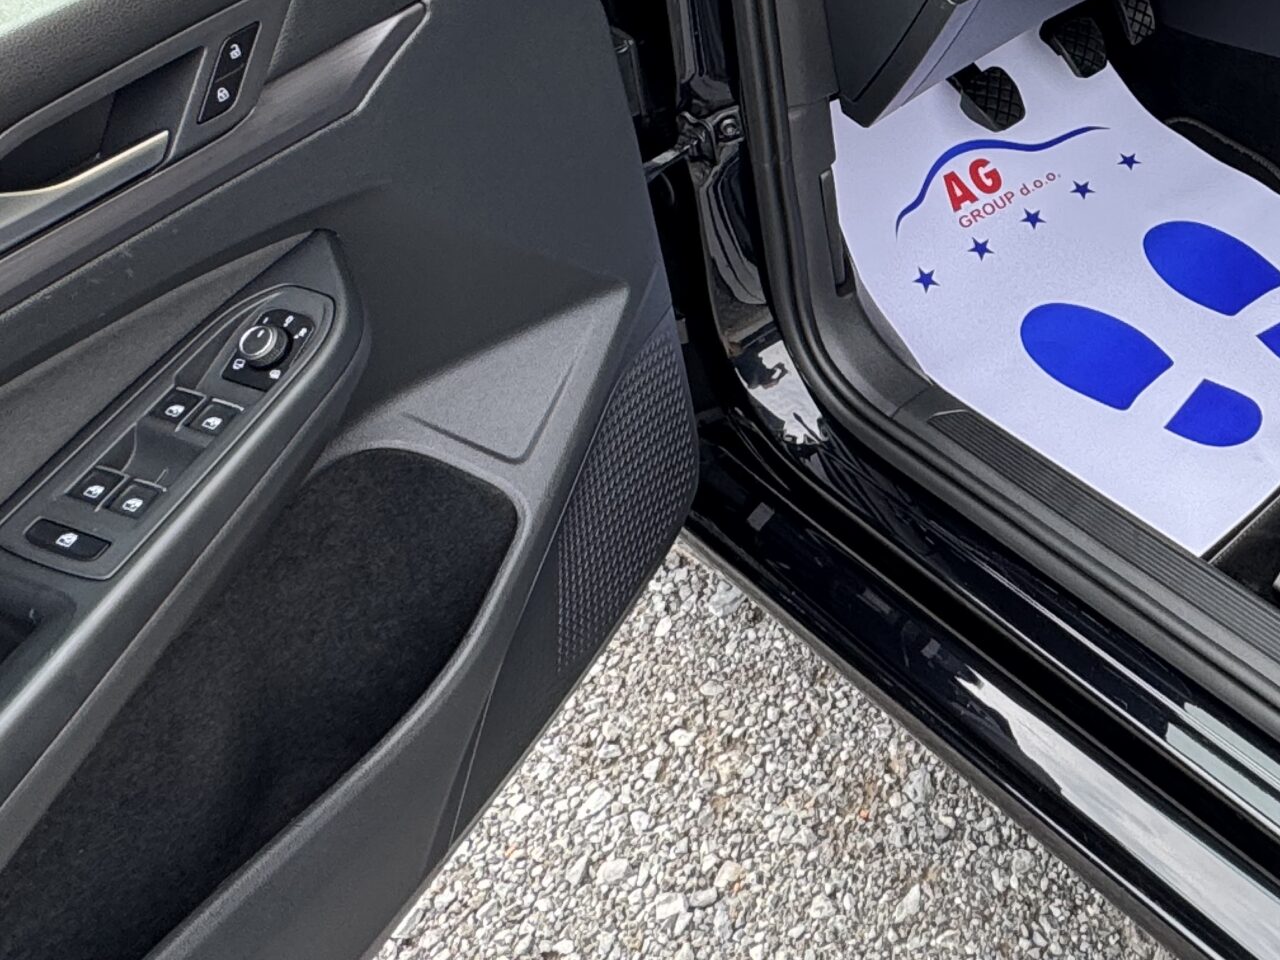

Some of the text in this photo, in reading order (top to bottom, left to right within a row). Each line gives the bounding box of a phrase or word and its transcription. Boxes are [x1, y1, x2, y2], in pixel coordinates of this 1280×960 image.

[943, 158, 1003, 213] AG
[958, 171, 1062, 229] GROUP d.o.o.
